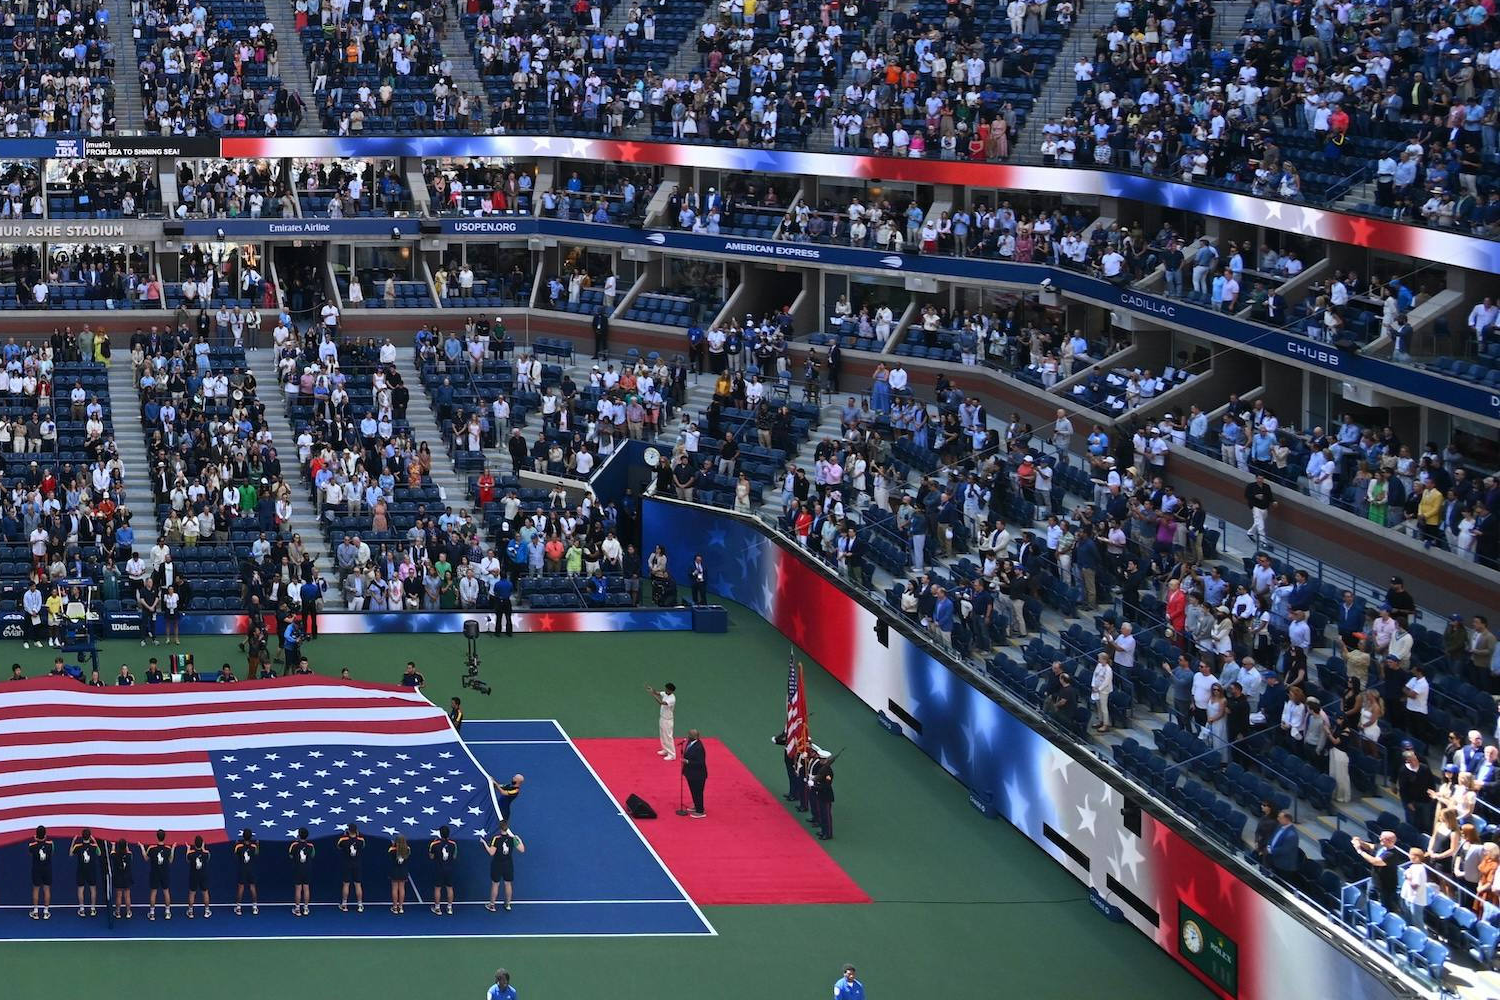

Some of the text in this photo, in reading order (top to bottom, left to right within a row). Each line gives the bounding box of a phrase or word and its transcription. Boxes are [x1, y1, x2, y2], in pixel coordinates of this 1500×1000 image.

[86, 141, 111, 149] (music)
[55, 147, 79, 157] IBM
[26, 226, 61, 236] ASHE
[66, 226, 124, 236] STADIUM
[269, 223, 330, 232] Emirates Airline
[455, 222, 517, 231] USOPEN.ORG
[725, 242, 820, 258] AMERICAN EXPRESS
[1121, 294, 1175, 317] CADILLAC
[1288, 342, 1339, 365] CHUBB
[111, 623, 140, 631] Wilson
[3, 629, 24, 637] evian
